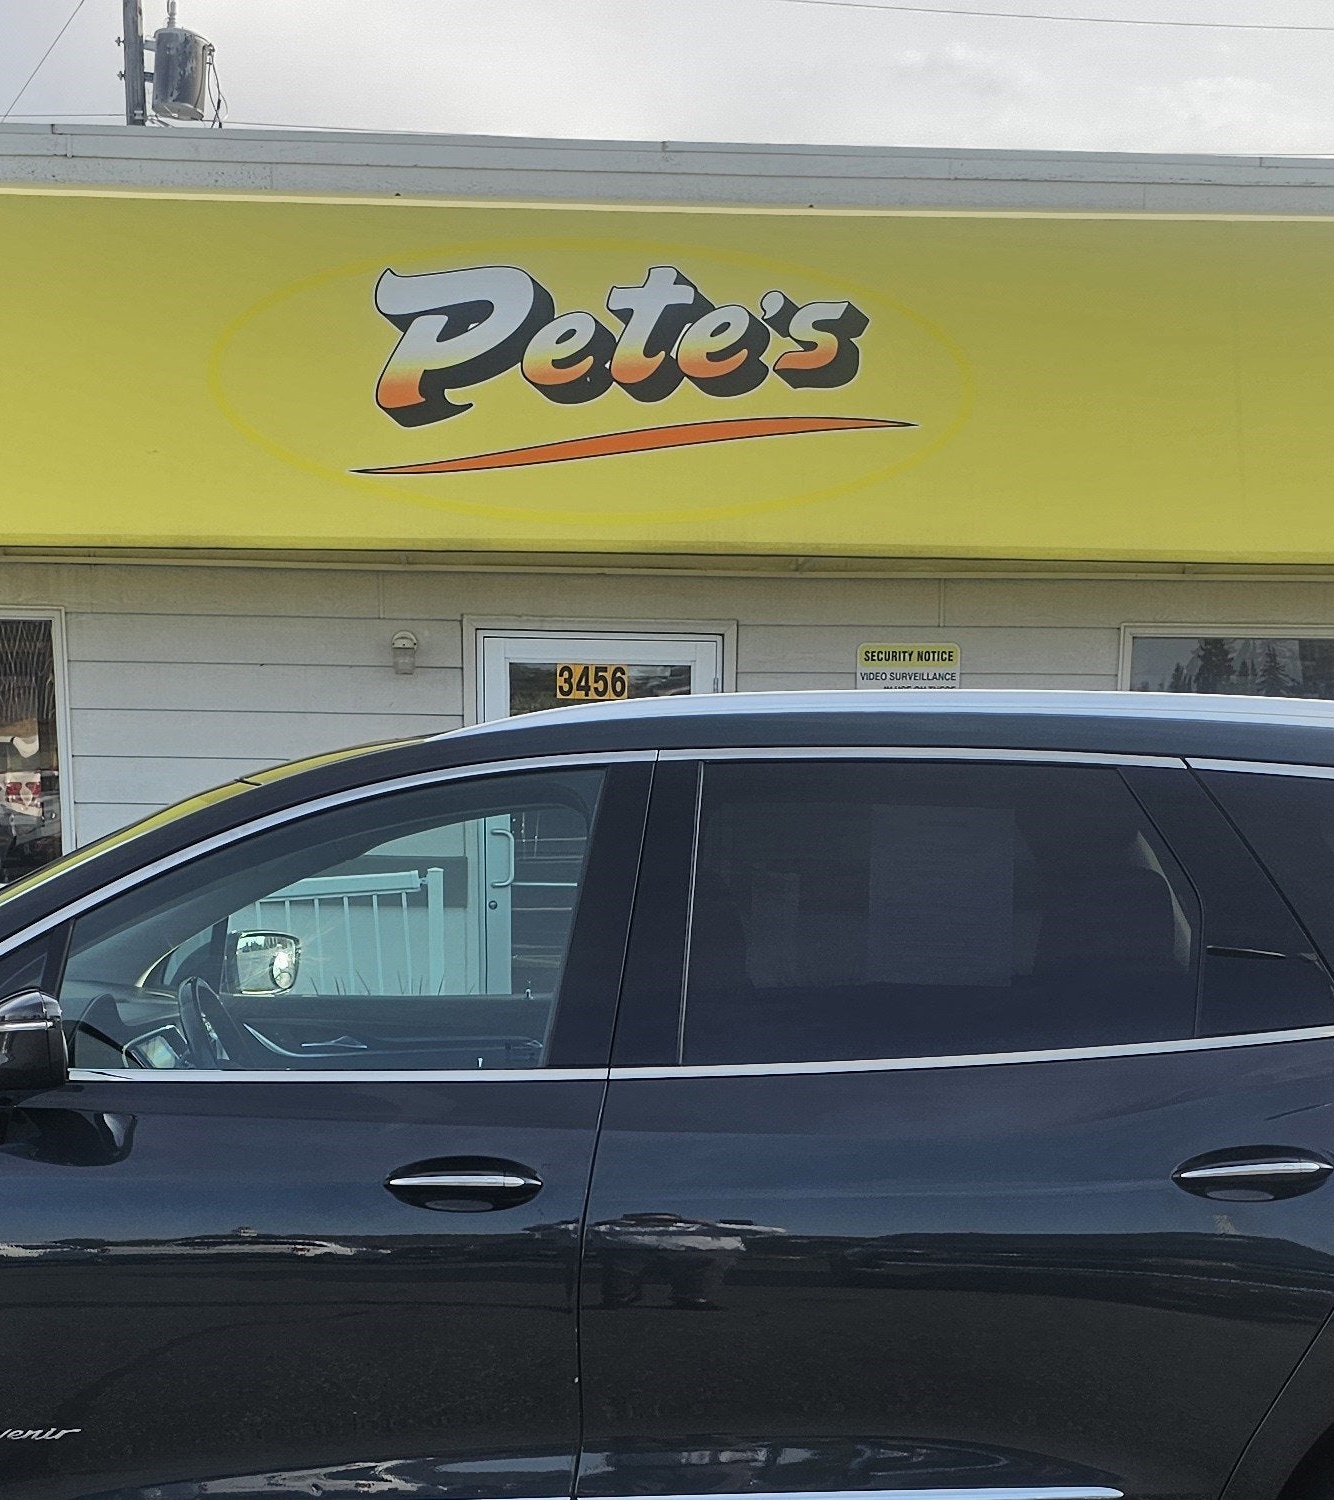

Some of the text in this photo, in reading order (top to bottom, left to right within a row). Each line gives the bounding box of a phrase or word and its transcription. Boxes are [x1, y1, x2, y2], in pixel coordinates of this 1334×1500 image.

[375, 264, 869, 428] Pete's
[864, 650, 954, 662] SECURITY NOTICE
[558, 665, 626, 698] 3456
[860, 672, 957, 681] VIDEO SURVEILLANCE
